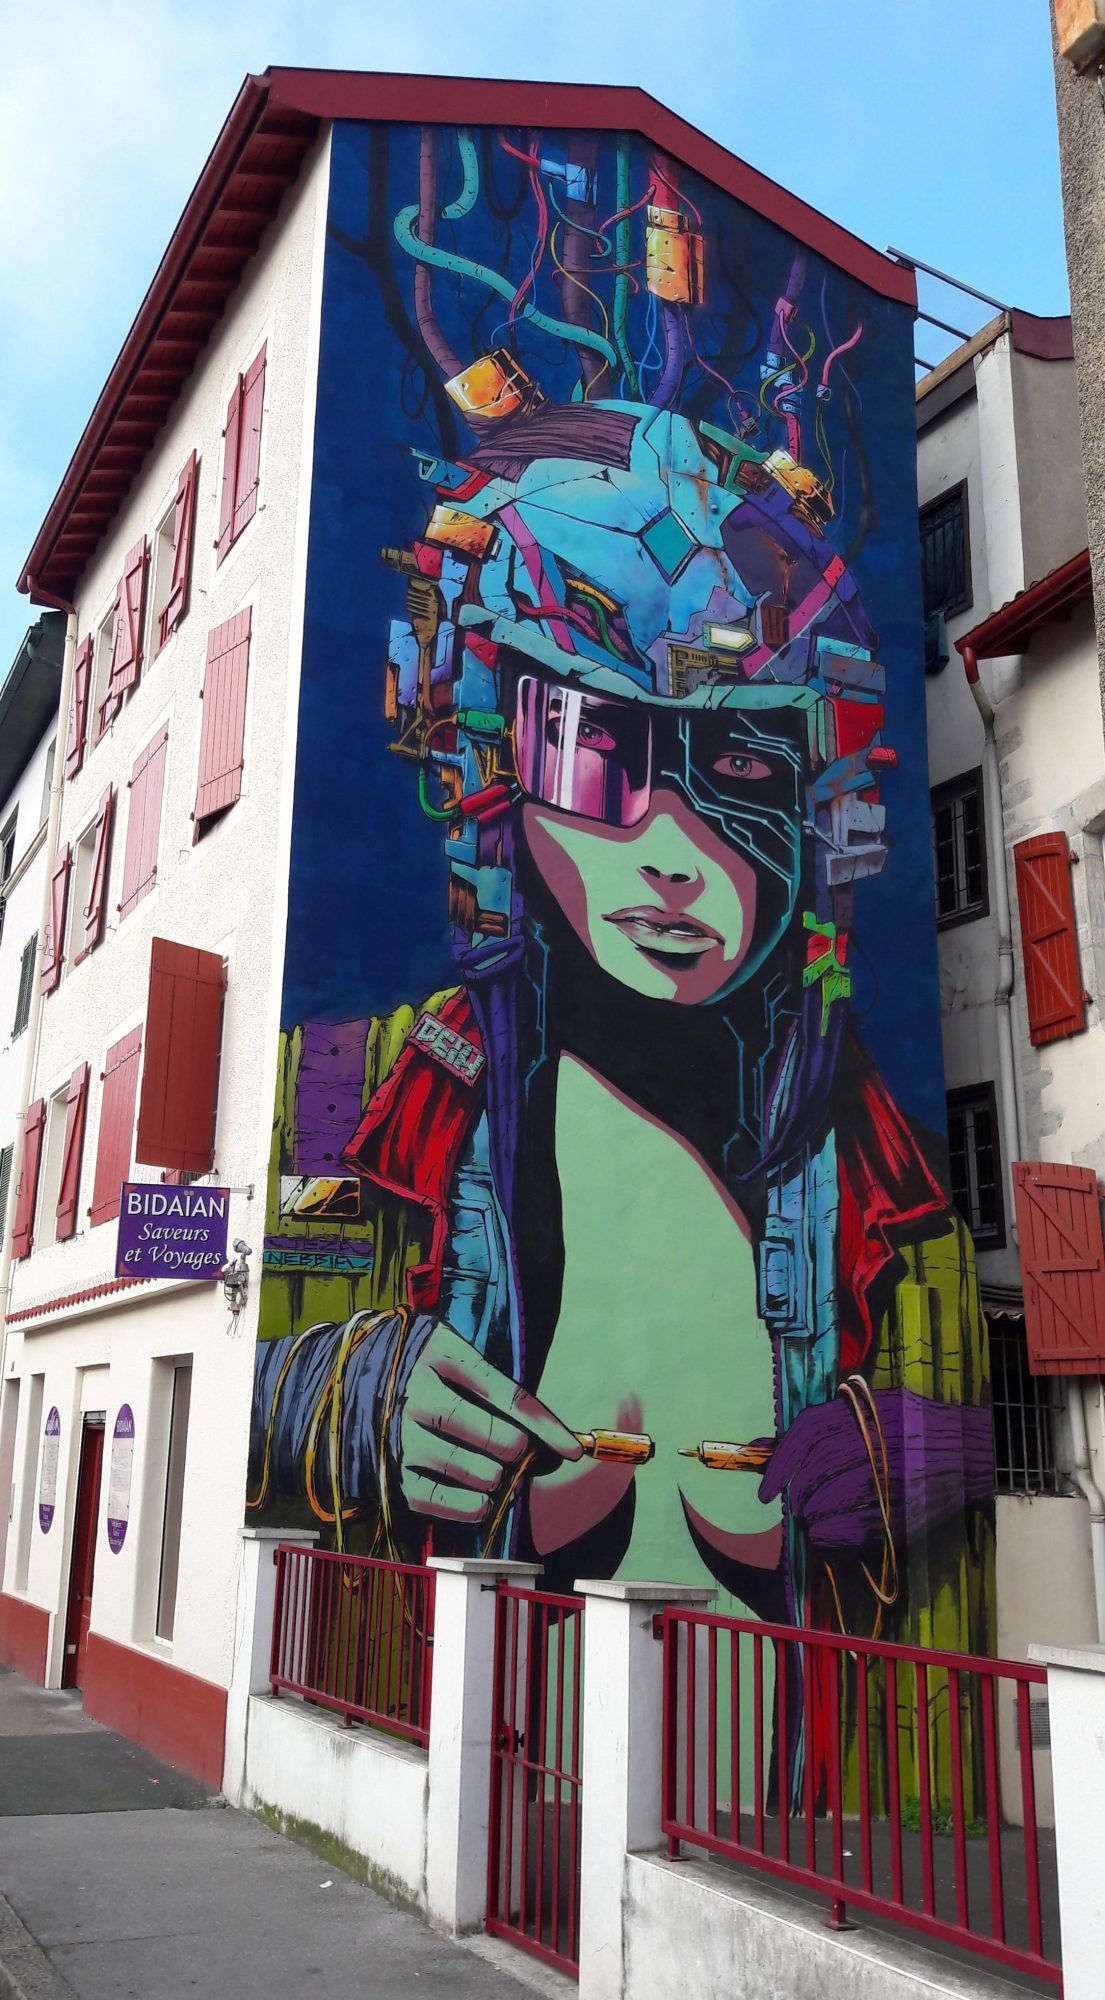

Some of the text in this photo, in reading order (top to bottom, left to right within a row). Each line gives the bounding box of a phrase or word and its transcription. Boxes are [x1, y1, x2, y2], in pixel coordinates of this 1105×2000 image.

[127, 1190, 225, 1218] BIDAÏAN
[138, 1223, 210, 1241] Saveurs
[124, 1244, 222, 1270] et Voyages
